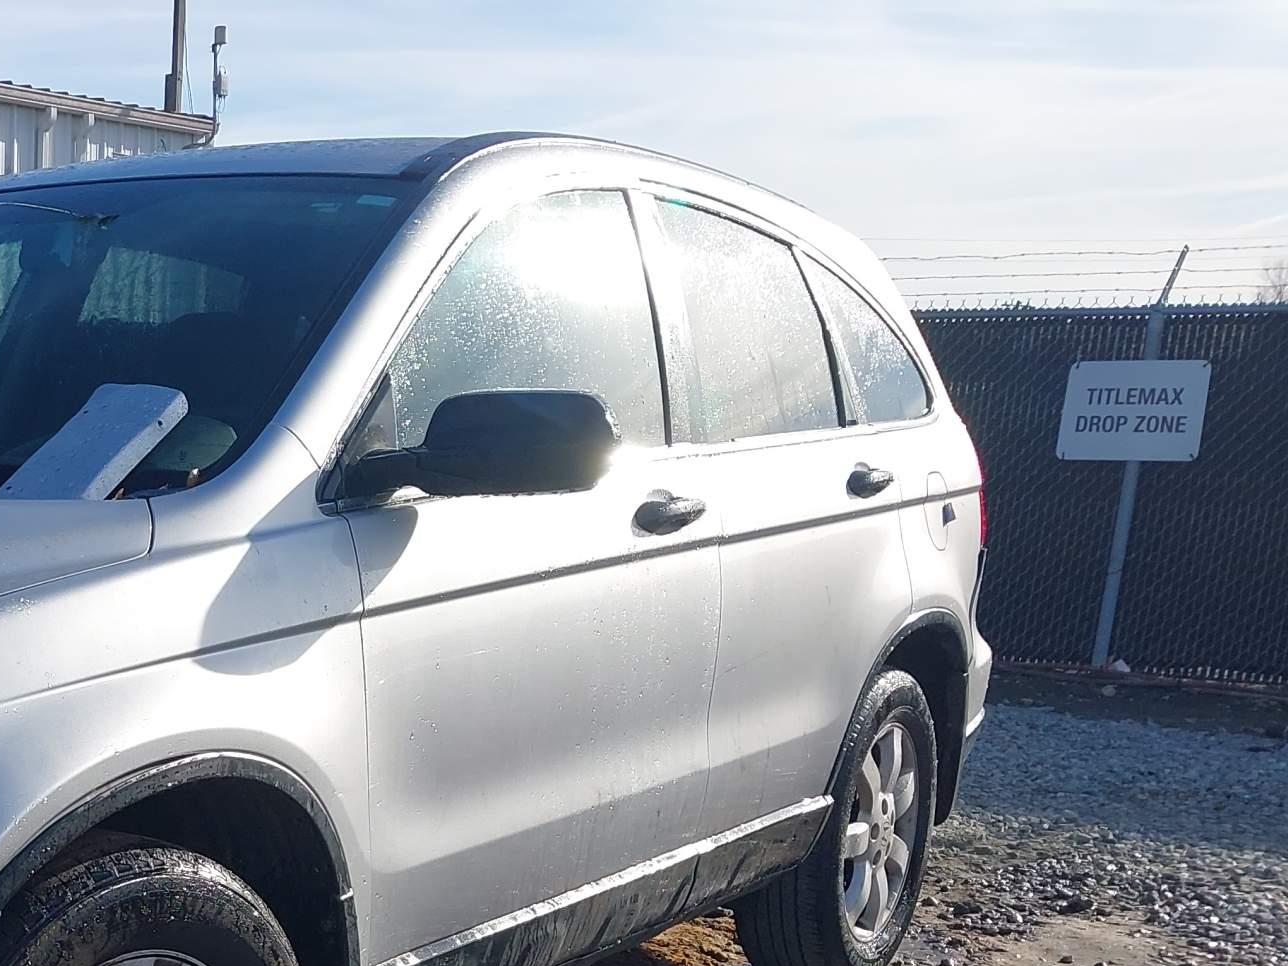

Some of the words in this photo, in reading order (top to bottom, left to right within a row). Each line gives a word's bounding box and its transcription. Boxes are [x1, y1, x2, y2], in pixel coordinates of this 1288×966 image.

[1087, 387, 1185, 405] TITLEMAX
[1075, 415, 1128, 433] DROP
[1132, 415, 1188, 433] ZONE
